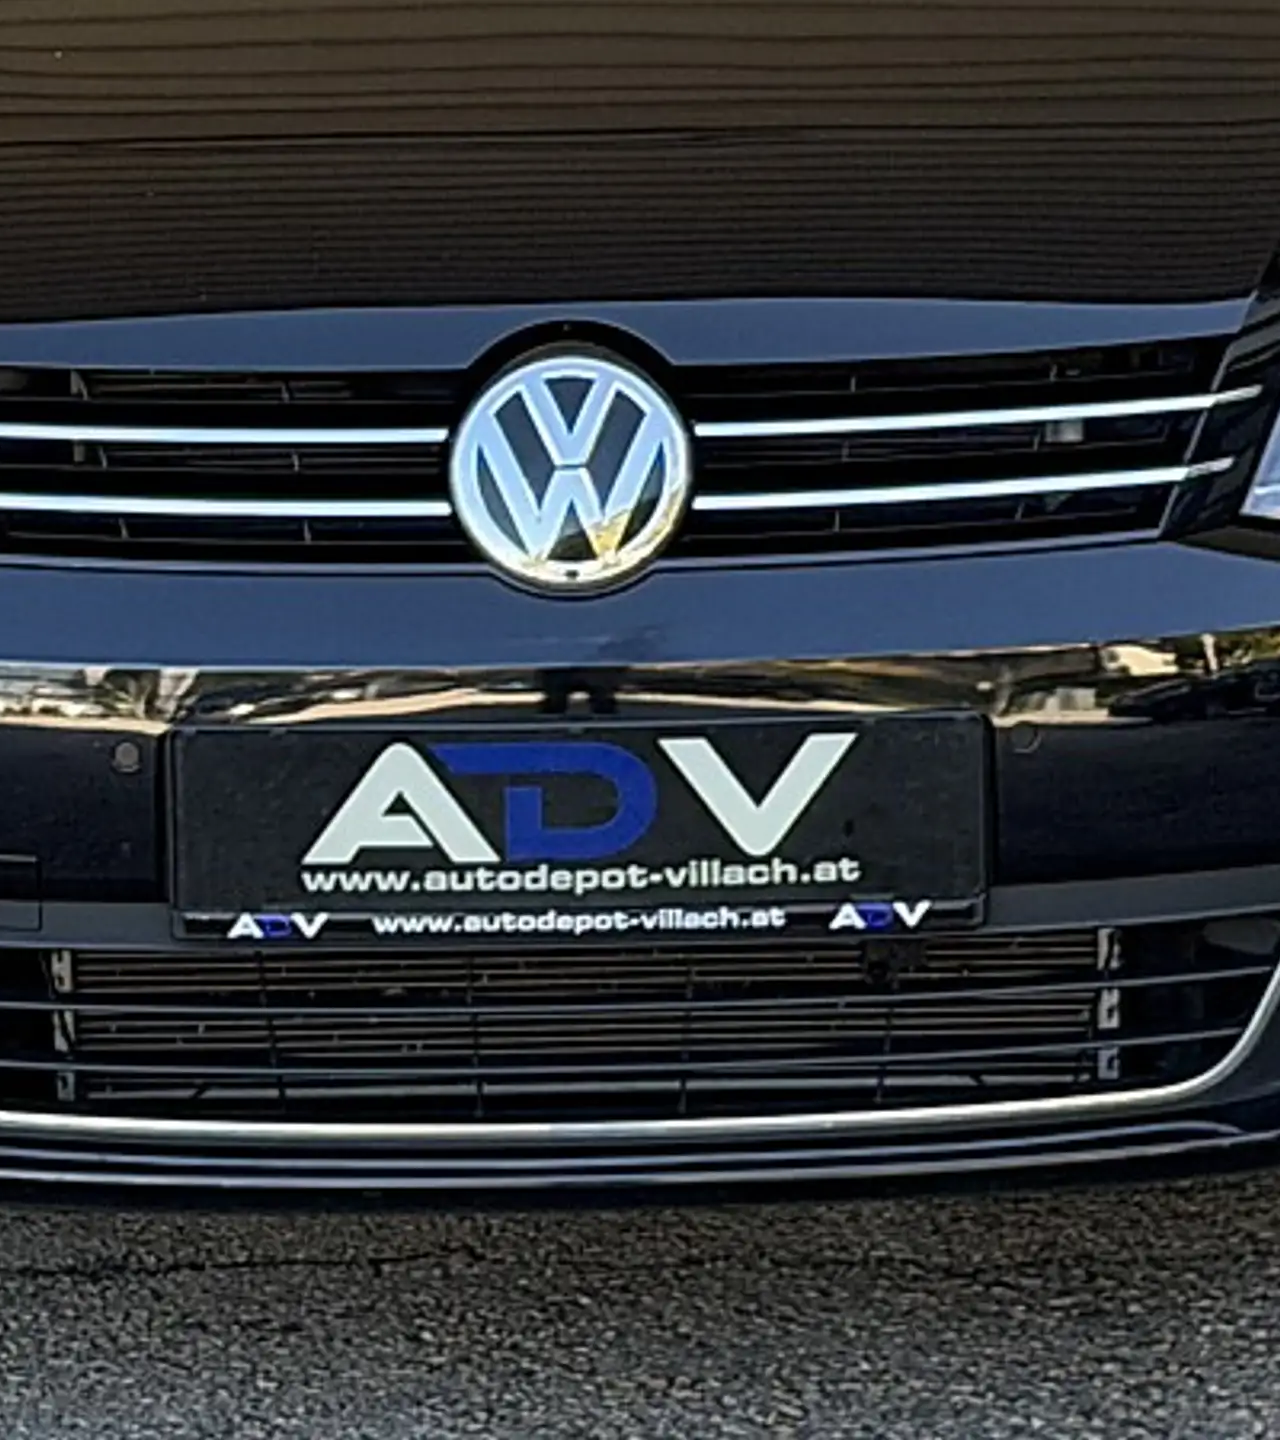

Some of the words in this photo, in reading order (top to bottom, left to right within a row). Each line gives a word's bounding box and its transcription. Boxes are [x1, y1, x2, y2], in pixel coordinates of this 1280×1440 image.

[301, 733, 857, 863] ADV
[301, 857, 861, 895] www.autodepot-villach.at
[227, 913, 329, 939] ADV
[372, 907, 786, 936] www.autodepot-villach.at
[829, 901, 932, 930] ADV
